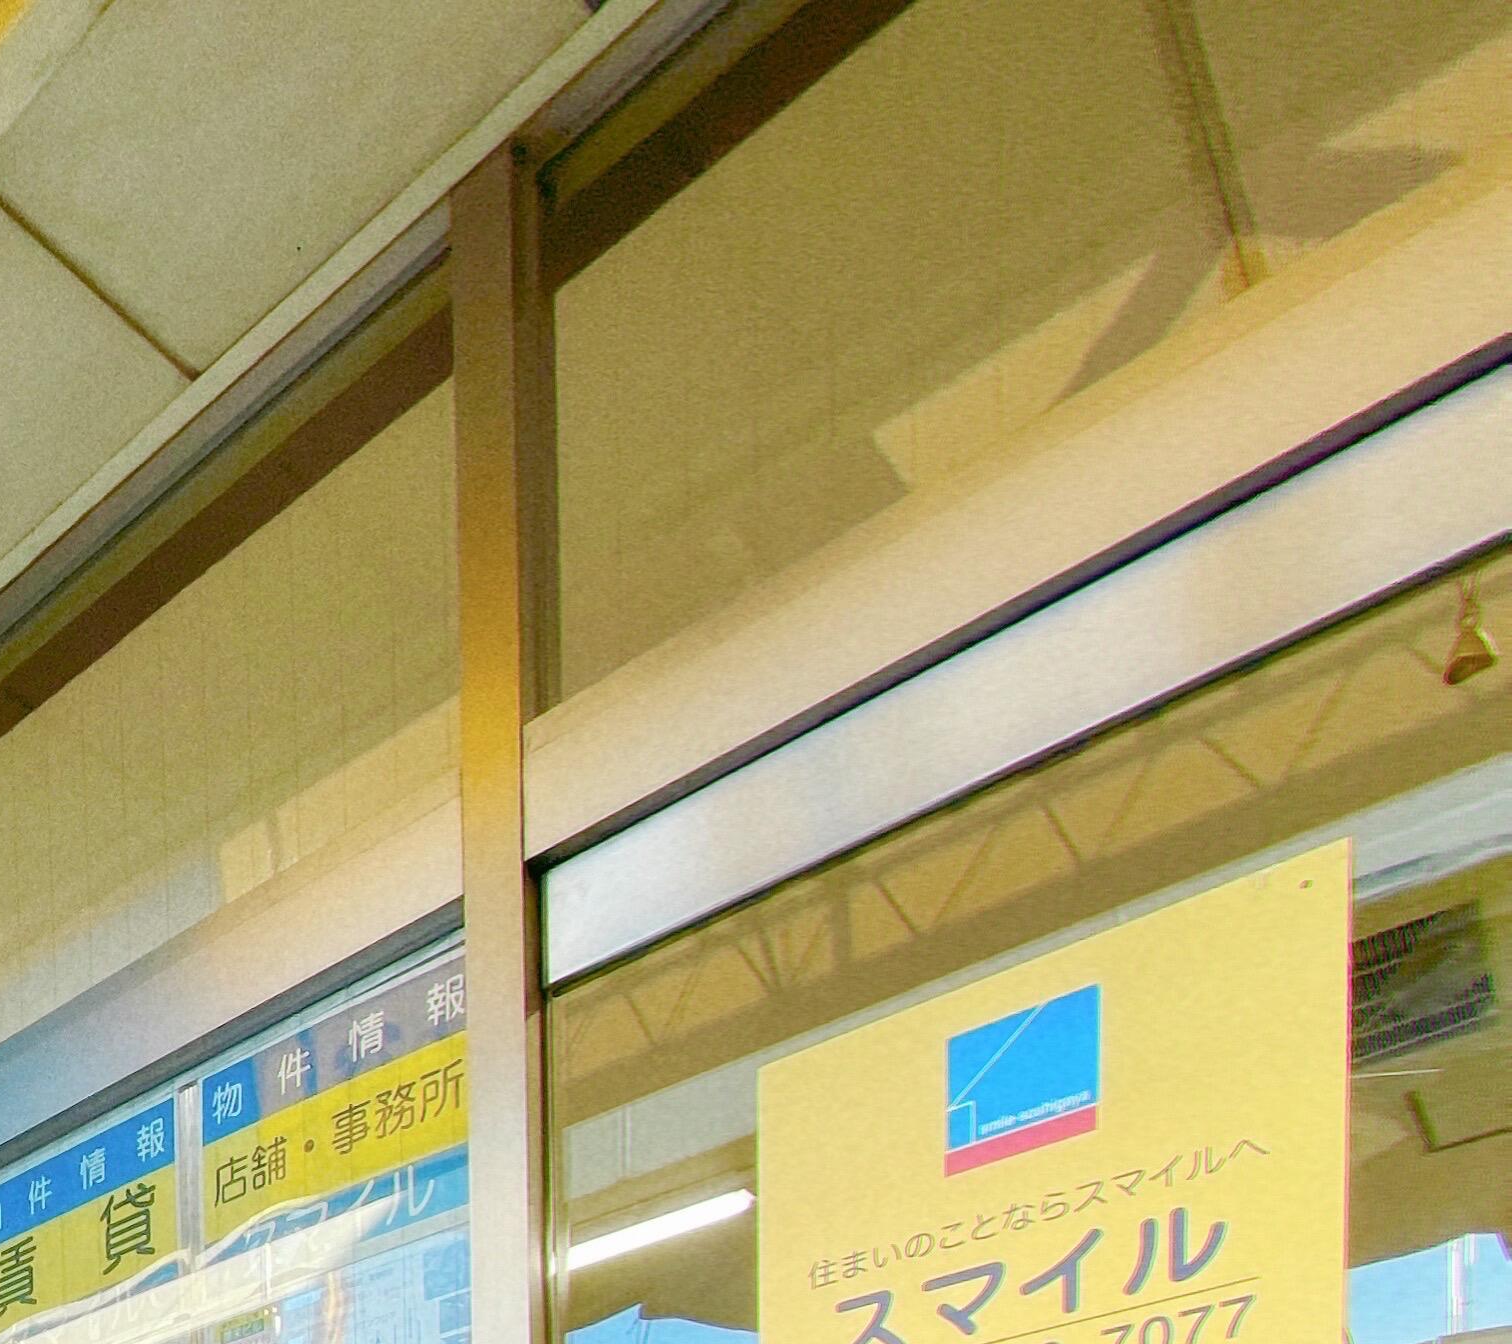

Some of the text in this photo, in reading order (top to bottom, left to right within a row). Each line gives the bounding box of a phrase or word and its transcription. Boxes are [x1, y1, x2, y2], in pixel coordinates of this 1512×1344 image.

[213, 973, 465, 1124] 物件情報
[214, 1058, 465, 1208] 店舗・事務所
[807, 1138, 1271, 1290] 住まいのことならスマイルへ
